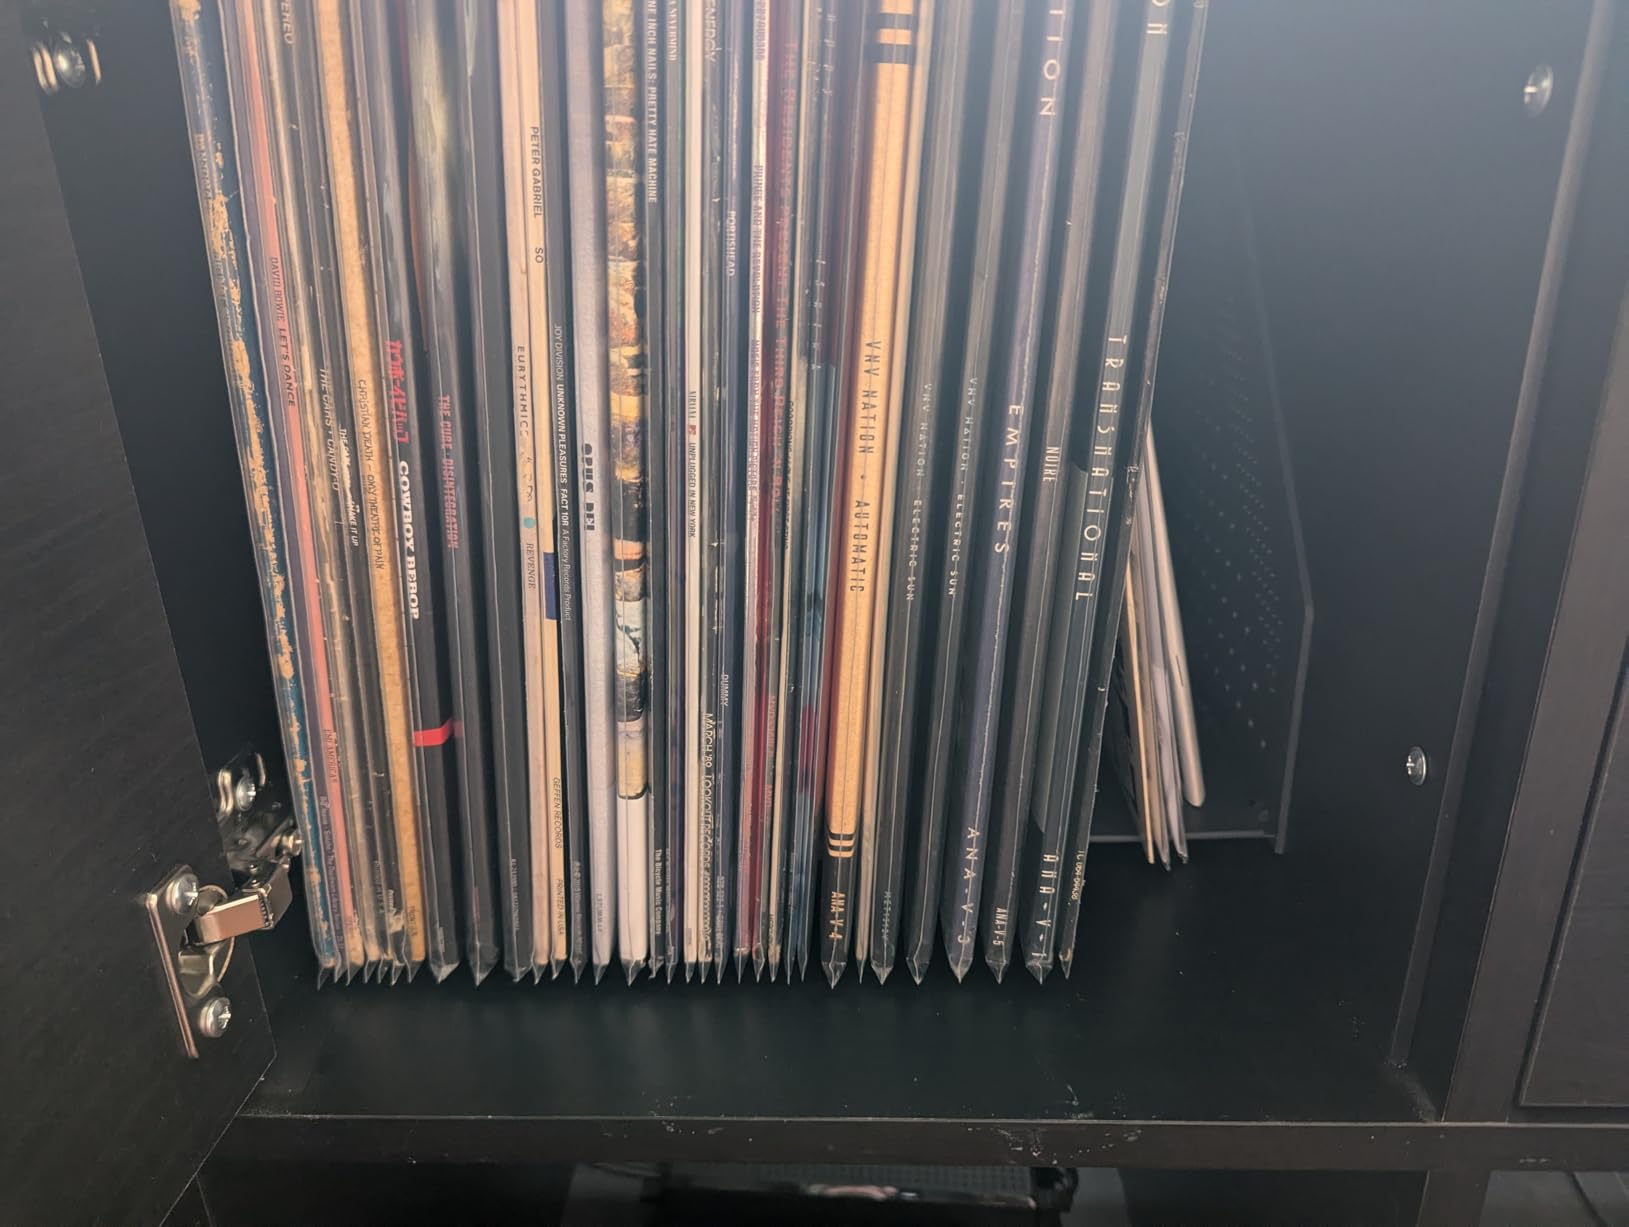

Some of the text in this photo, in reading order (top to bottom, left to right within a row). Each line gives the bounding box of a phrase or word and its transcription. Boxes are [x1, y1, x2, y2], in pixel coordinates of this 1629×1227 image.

[648, 18, 657, 44] INCH
[668, 8, 678, 61] NEVERMIND
[648, 47, 657, 83] NAILS:
[648, 86, 657, 125] PRETTY
[648, 129, 657, 155] HATE
[530, 126, 544, 264] PETER GABRIEL SO
[648, 158, 657, 203] MACHINE
[753, 205, 762, 225] AND
[270, 257, 295, 407] DAVID BOWIE LET'S DANCE
[554, 324, 562, 341] JOY
[319, 368, 329, 391] THE
[554, 342, 563, 381] DIVISION
[322, 395, 332, 426] CARS
[359, 379, 371, 430] CHRISTIAN
[556, 384, 565, 432] UNKNOWN
[362, 432, 373, 461] DEATH
[558, 434, 567, 484] PLEASURES
[688, 442, 697, 488] UNPLUGGED
[720, 210, 735, 707] PORTISHEAD DUMMY
[438, 395, 459, 550] THE CURE DISINTEGRATION
[850, 340, 881, 593] VNV NATION AUTOMATIC
[994, 404, 1024, 554] EMPIRES
[1075, 334, 1126, 601] TRANSNATIONAL
[560, 488, 569, 511] FACT
[948, 377, 977, 596] VNV NATION ELECTRIC SUN
[688, 499, 697, 517] NEW
[399, 461, 419, 620] COWBOY BEBOP
[688, 518, 697, 538] YORK
[526, 543, 536, 590] REVENGE
[561, 536, 571, 563] Factory
[562, 564, 572, 592] Records
[563, 593, 573, 621] Product
[703, 713, 713, 752] MARCH
[553, 777, 562, 808] GEFFEN
[554, 810, 563, 848] RECORDS
[654, 862, 662, 885] Bicycle
